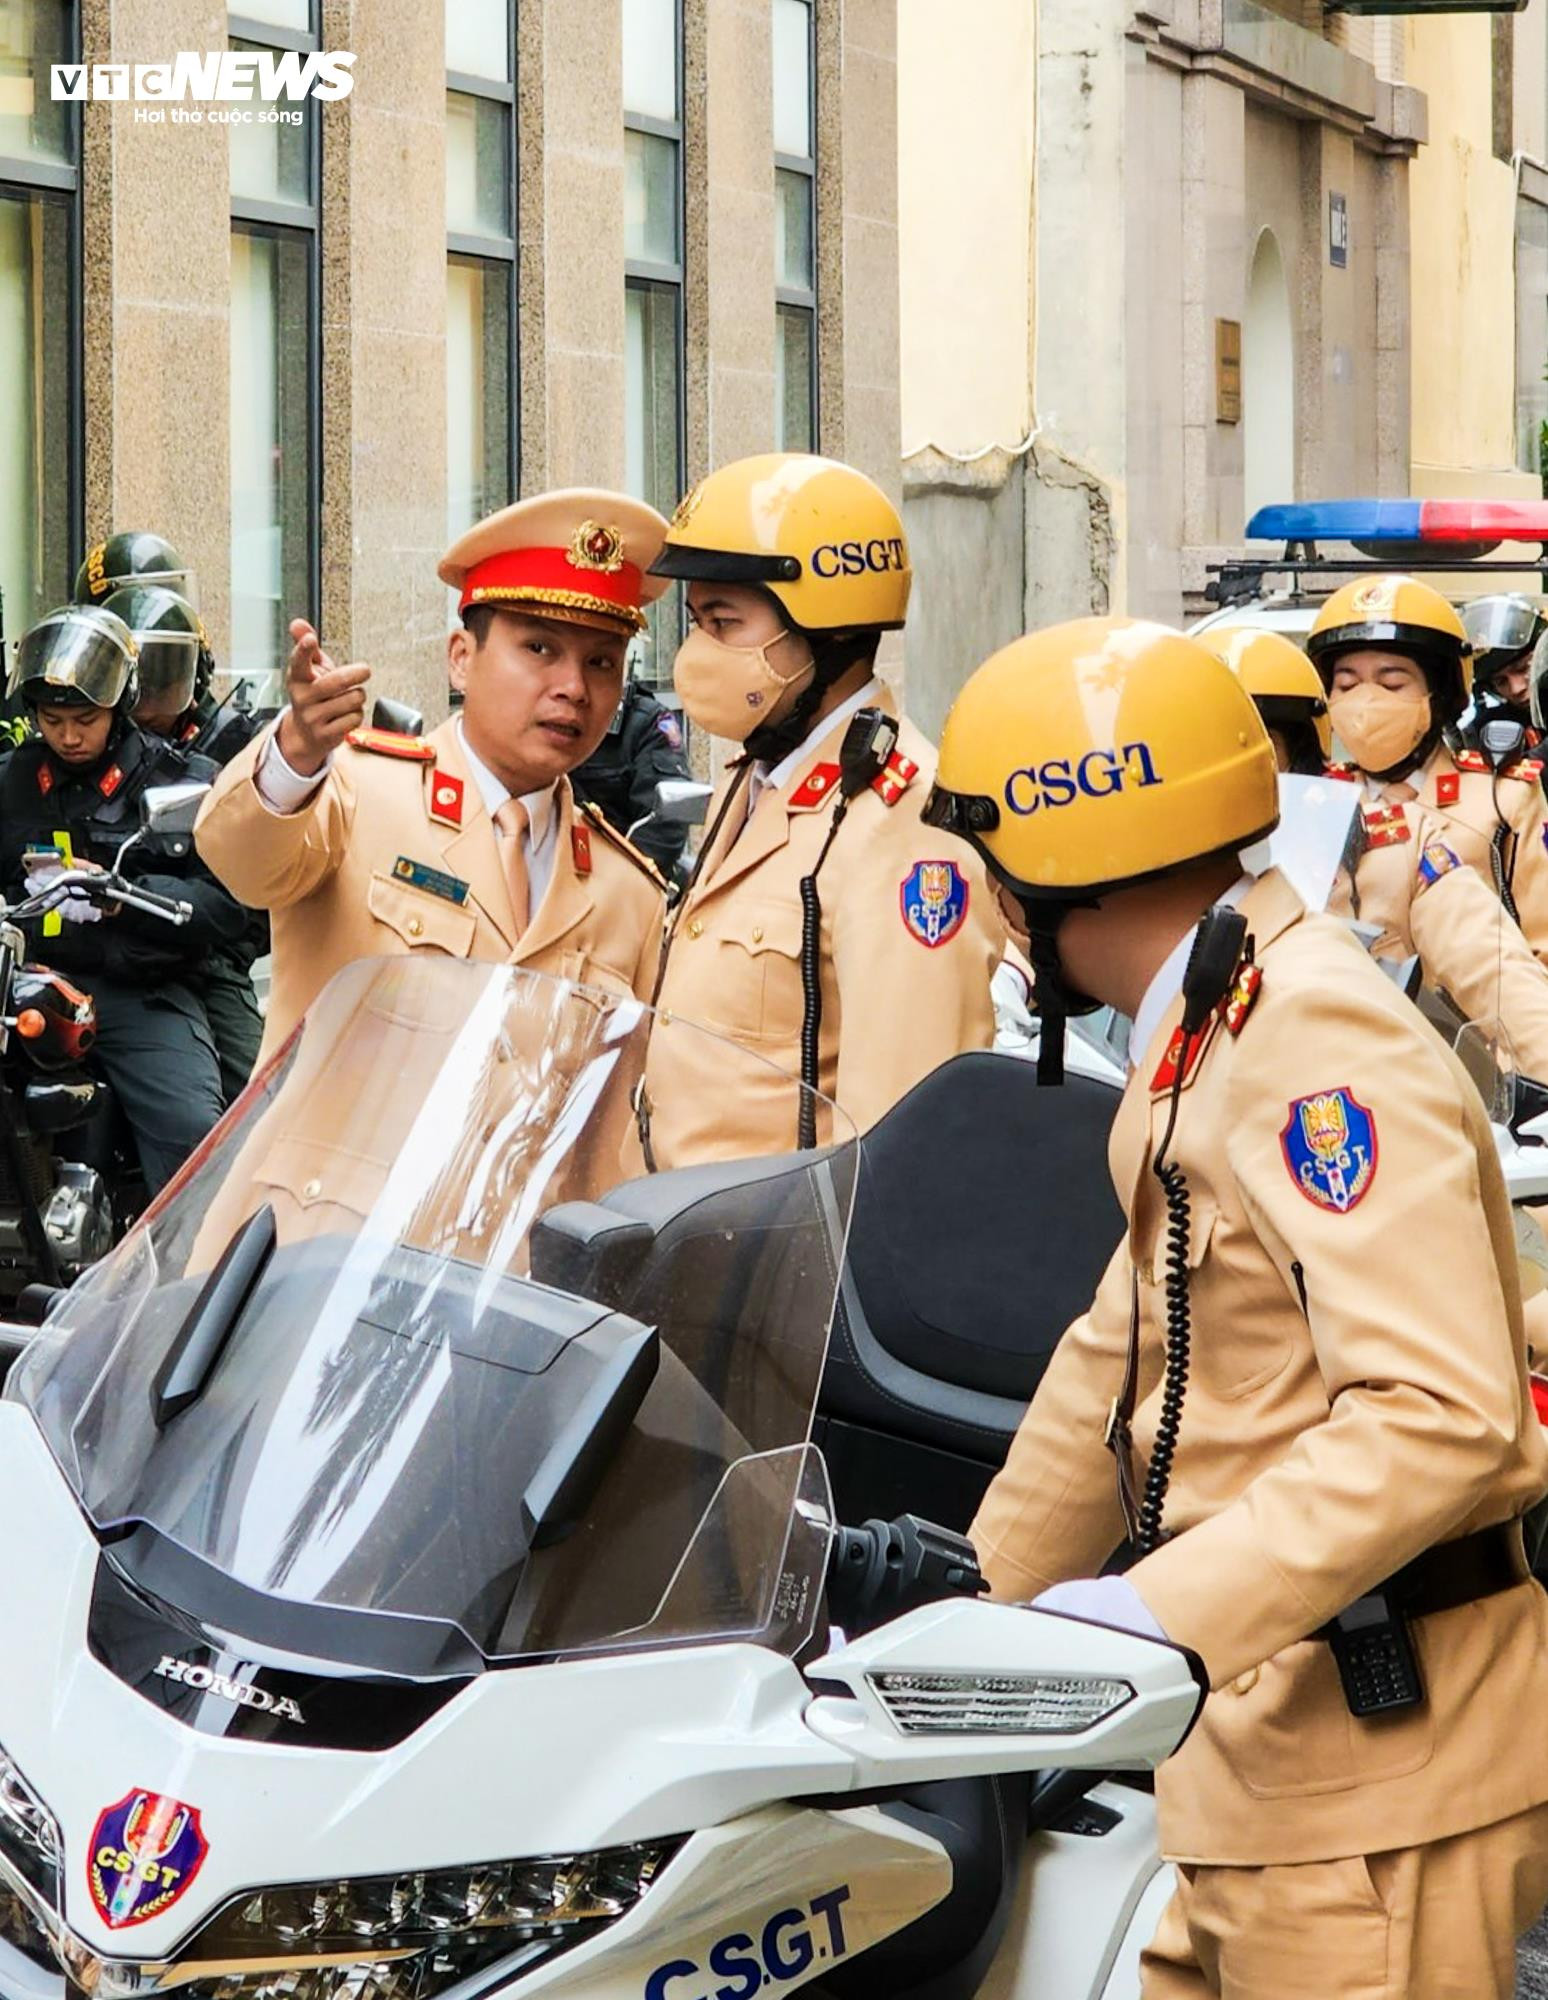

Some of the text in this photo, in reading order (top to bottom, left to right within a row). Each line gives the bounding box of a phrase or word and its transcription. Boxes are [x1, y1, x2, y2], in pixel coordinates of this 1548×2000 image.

[812, 538, 903, 578] CSGT
[1004, 742, 1164, 816] CSGT
[152, 1655, 307, 1724] HONDA
